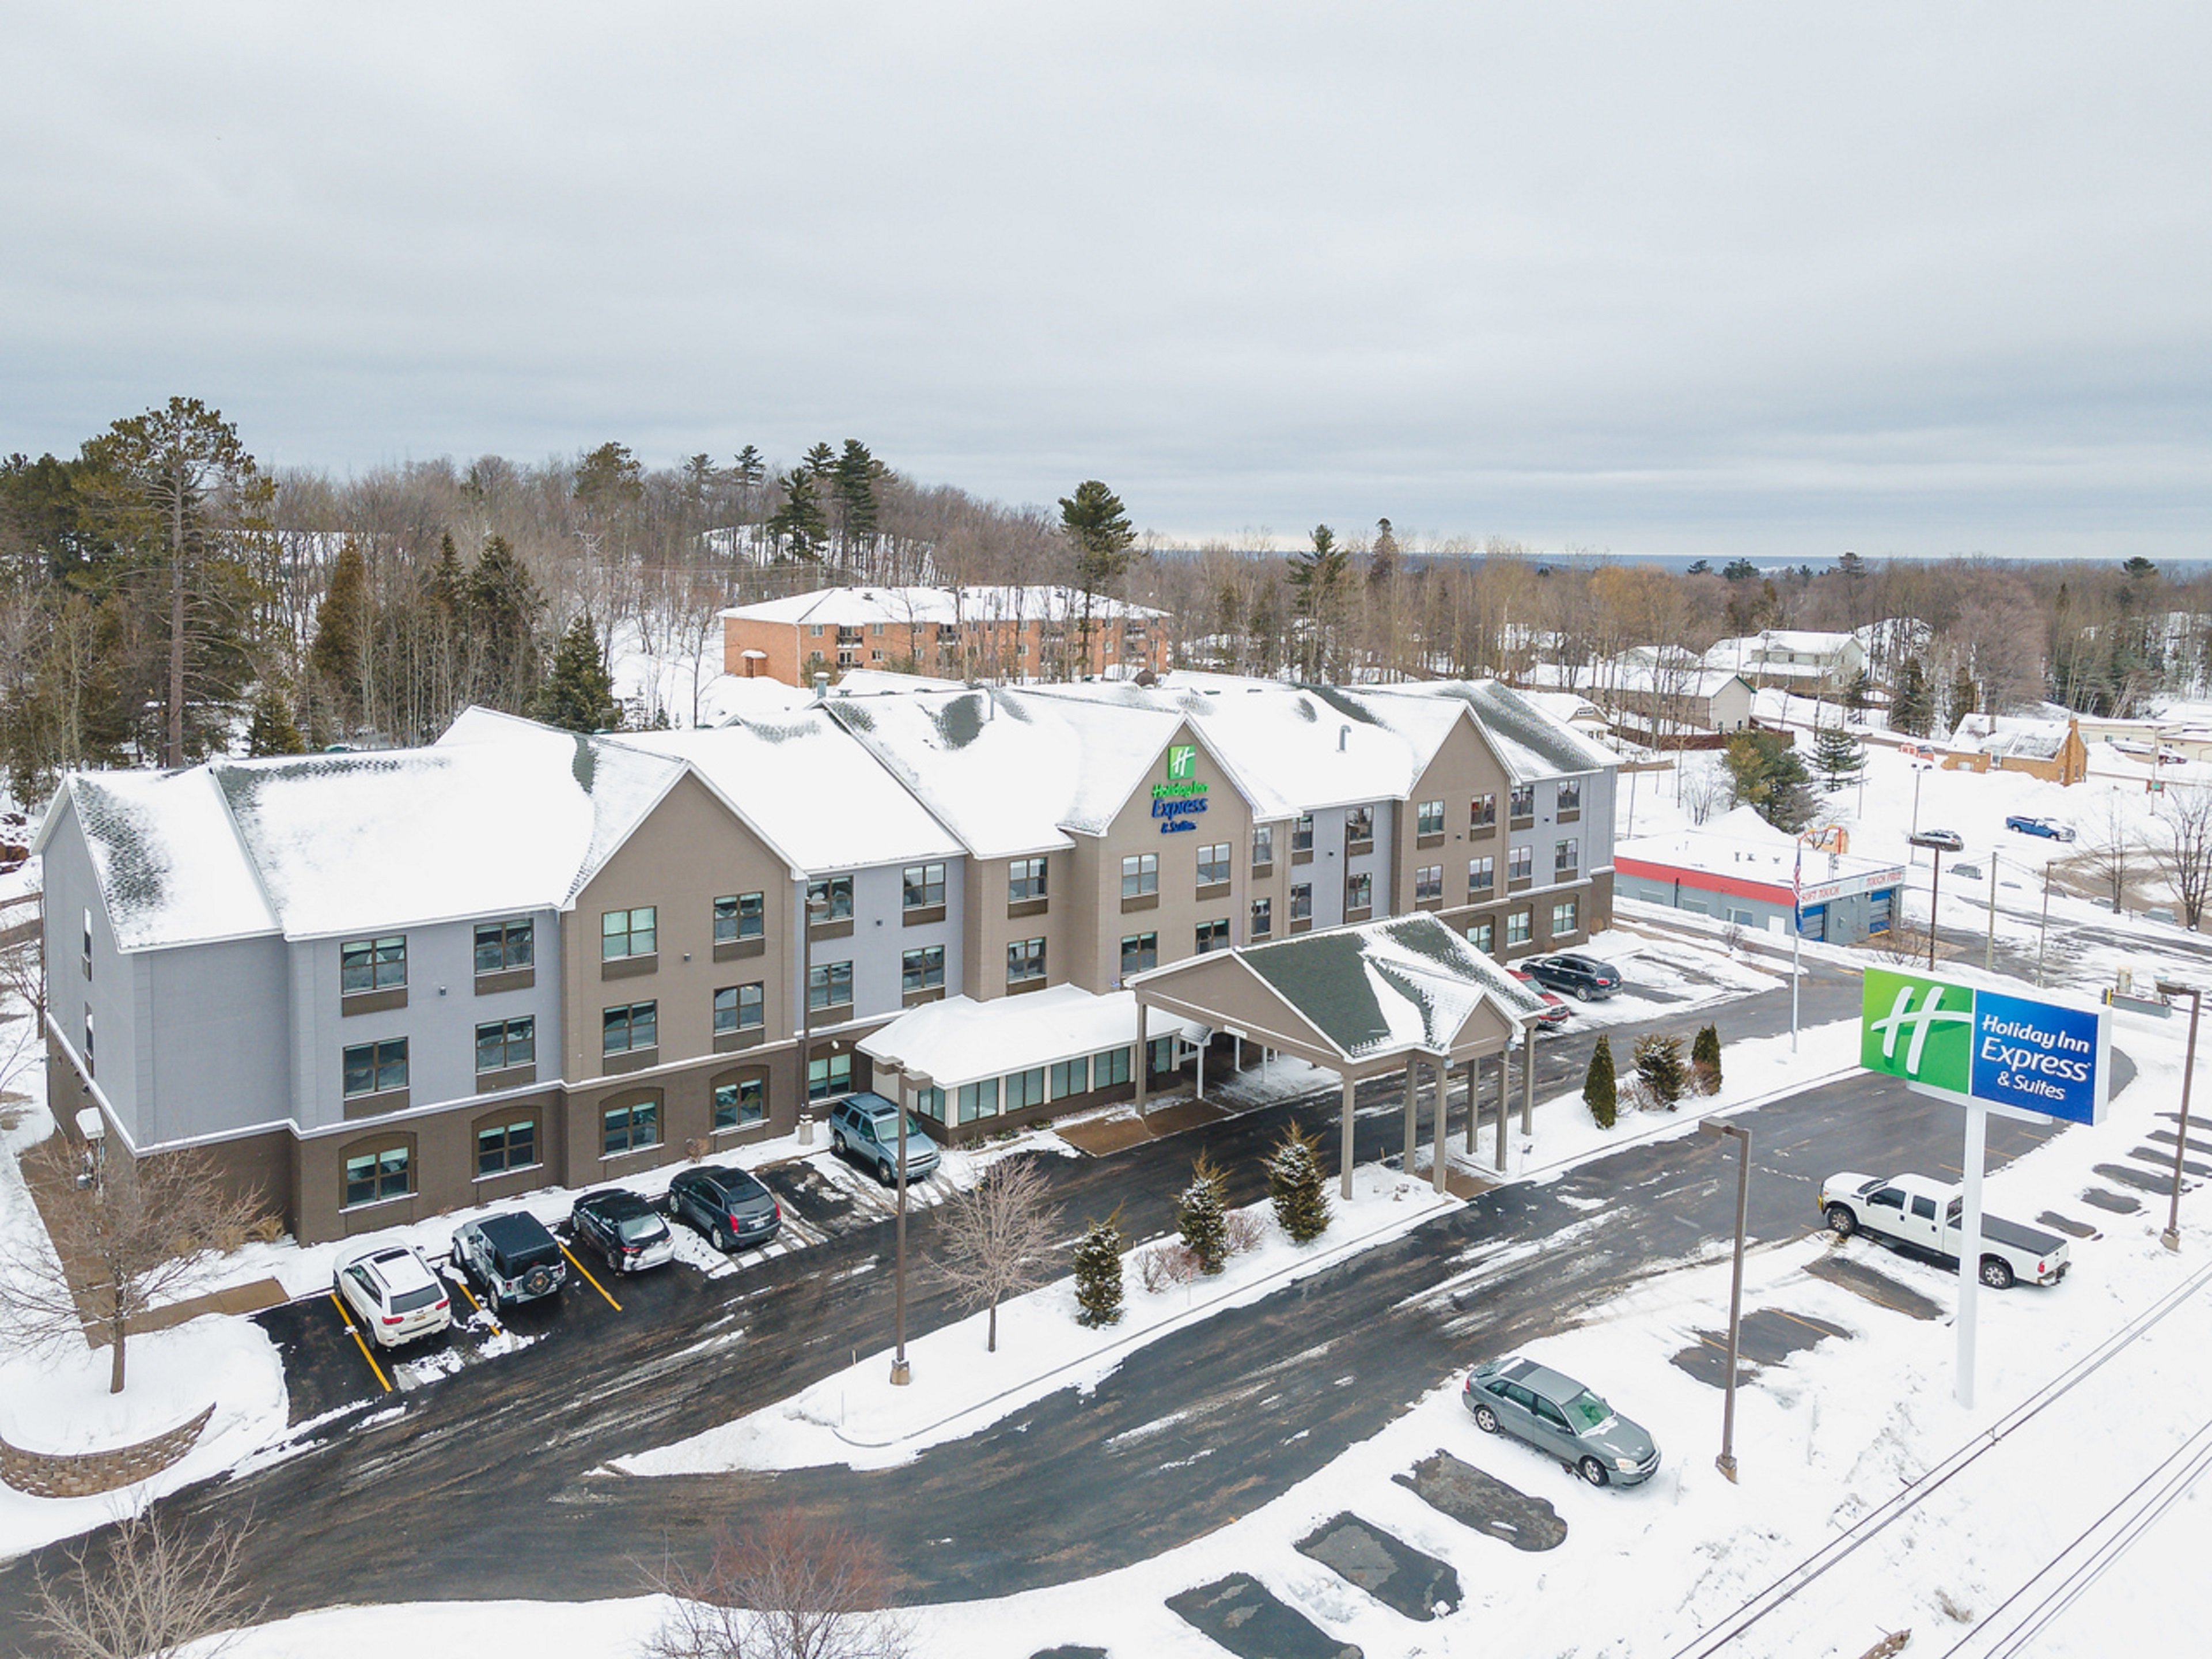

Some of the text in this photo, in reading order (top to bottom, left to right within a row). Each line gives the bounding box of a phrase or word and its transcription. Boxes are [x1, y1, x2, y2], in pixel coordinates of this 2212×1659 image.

[1152, 780, 1209, 798] Holiday Inn
[1152, 798, 1208, 820] Express
[1982, 1014, 2090, 1053] Holiday Inn
[1981, 1036, 2088, 1081] Express
[1997, 1070, 2066, 1100] & Suites
